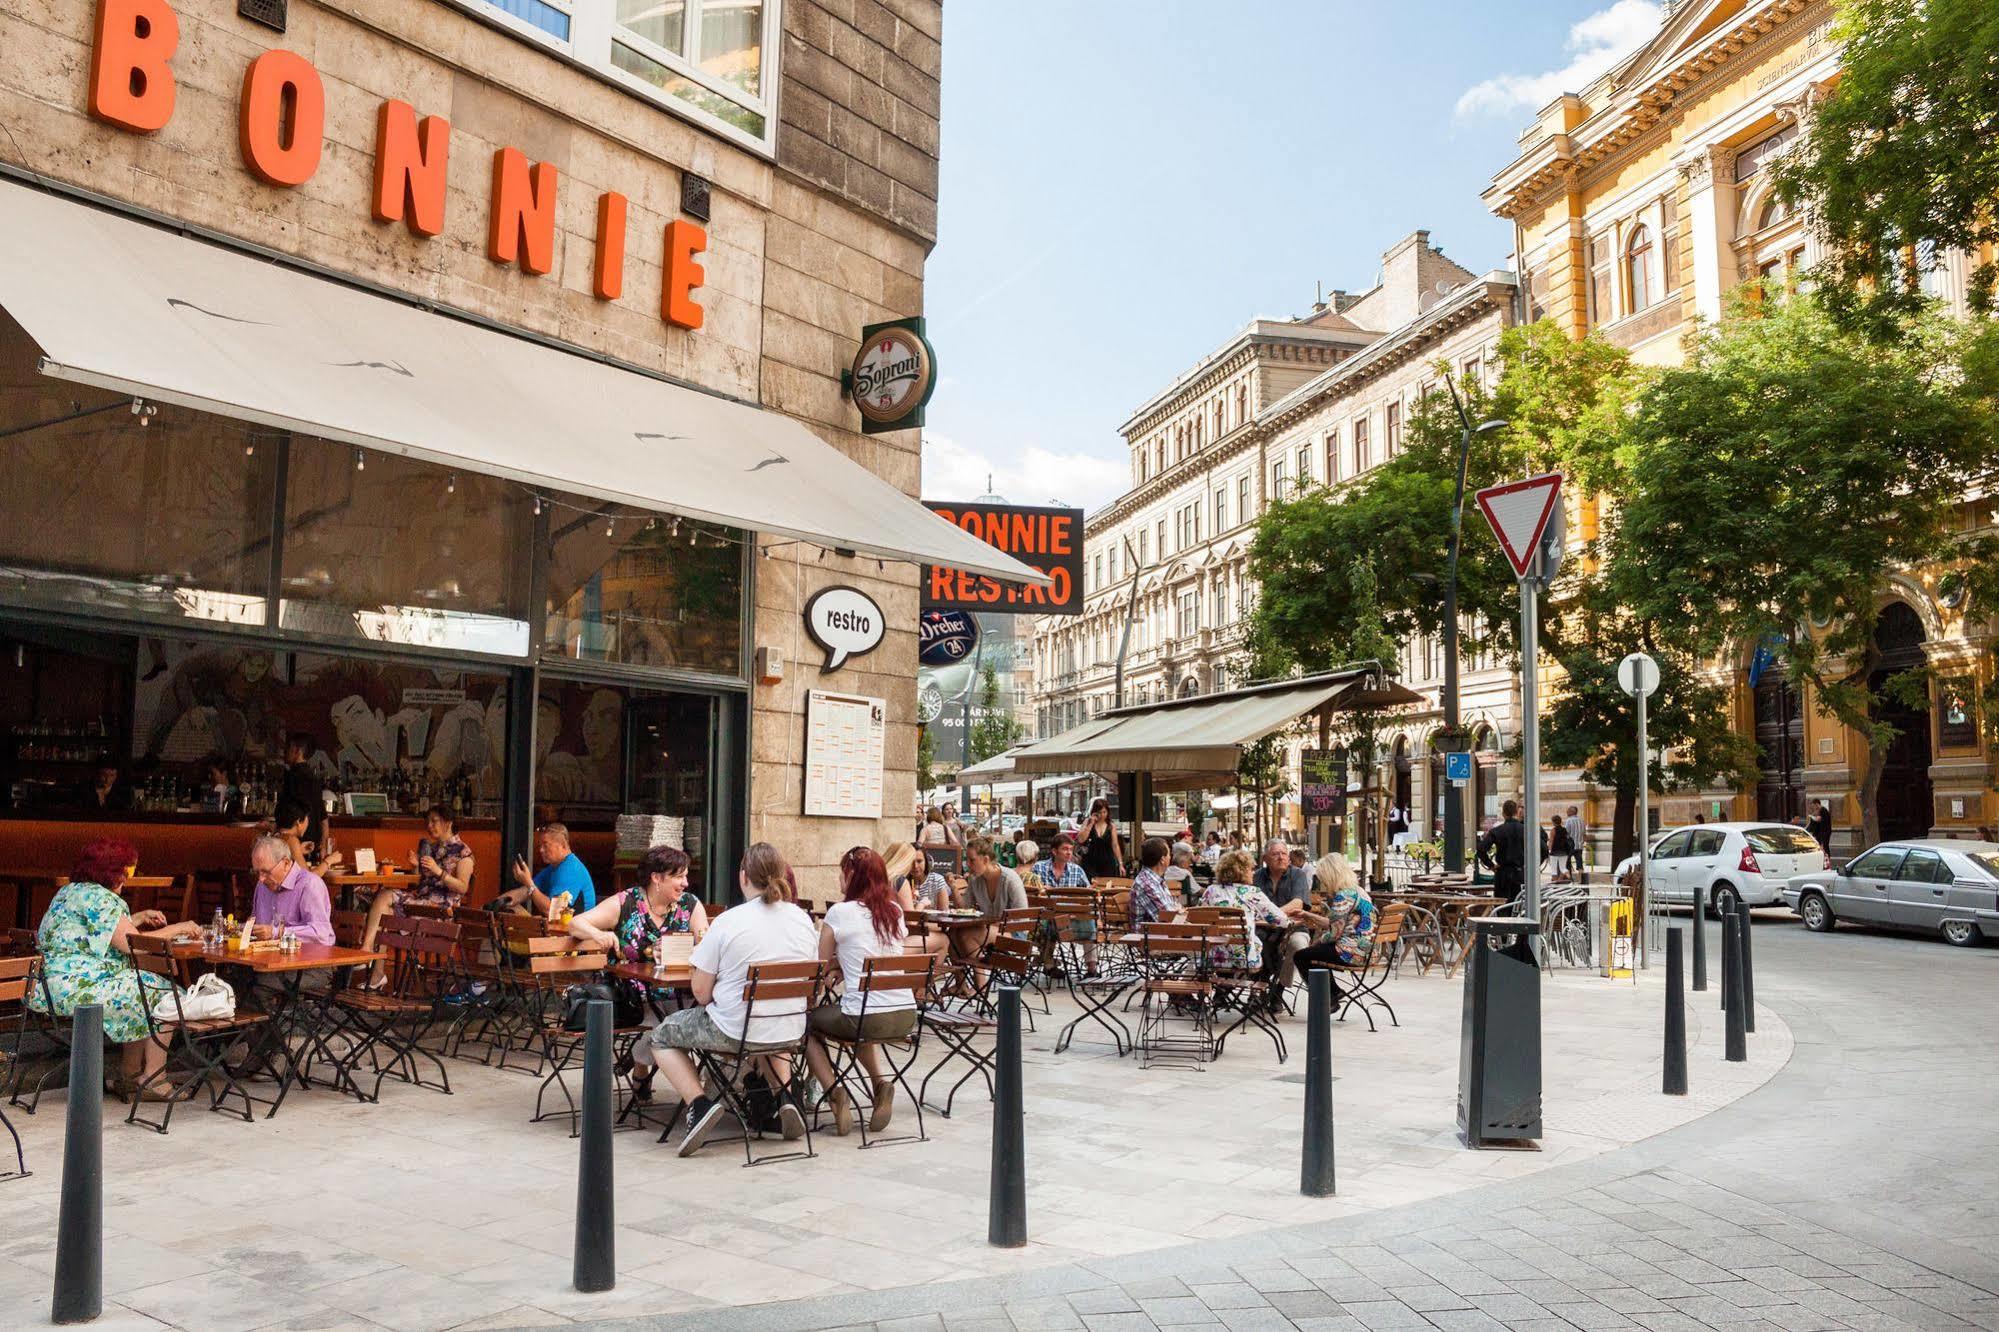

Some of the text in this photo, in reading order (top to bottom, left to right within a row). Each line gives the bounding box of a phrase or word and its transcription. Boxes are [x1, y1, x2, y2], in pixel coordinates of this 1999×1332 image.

[87, 0, 708, 330] BONNIE
[855, 352, 921, 398] Soproni
[827, 608, 870, 634] restro
[920, 617, 965, 641] Dreher
[946, 640, 962, 655] 24
[1449, 756, 1458, 768] P
